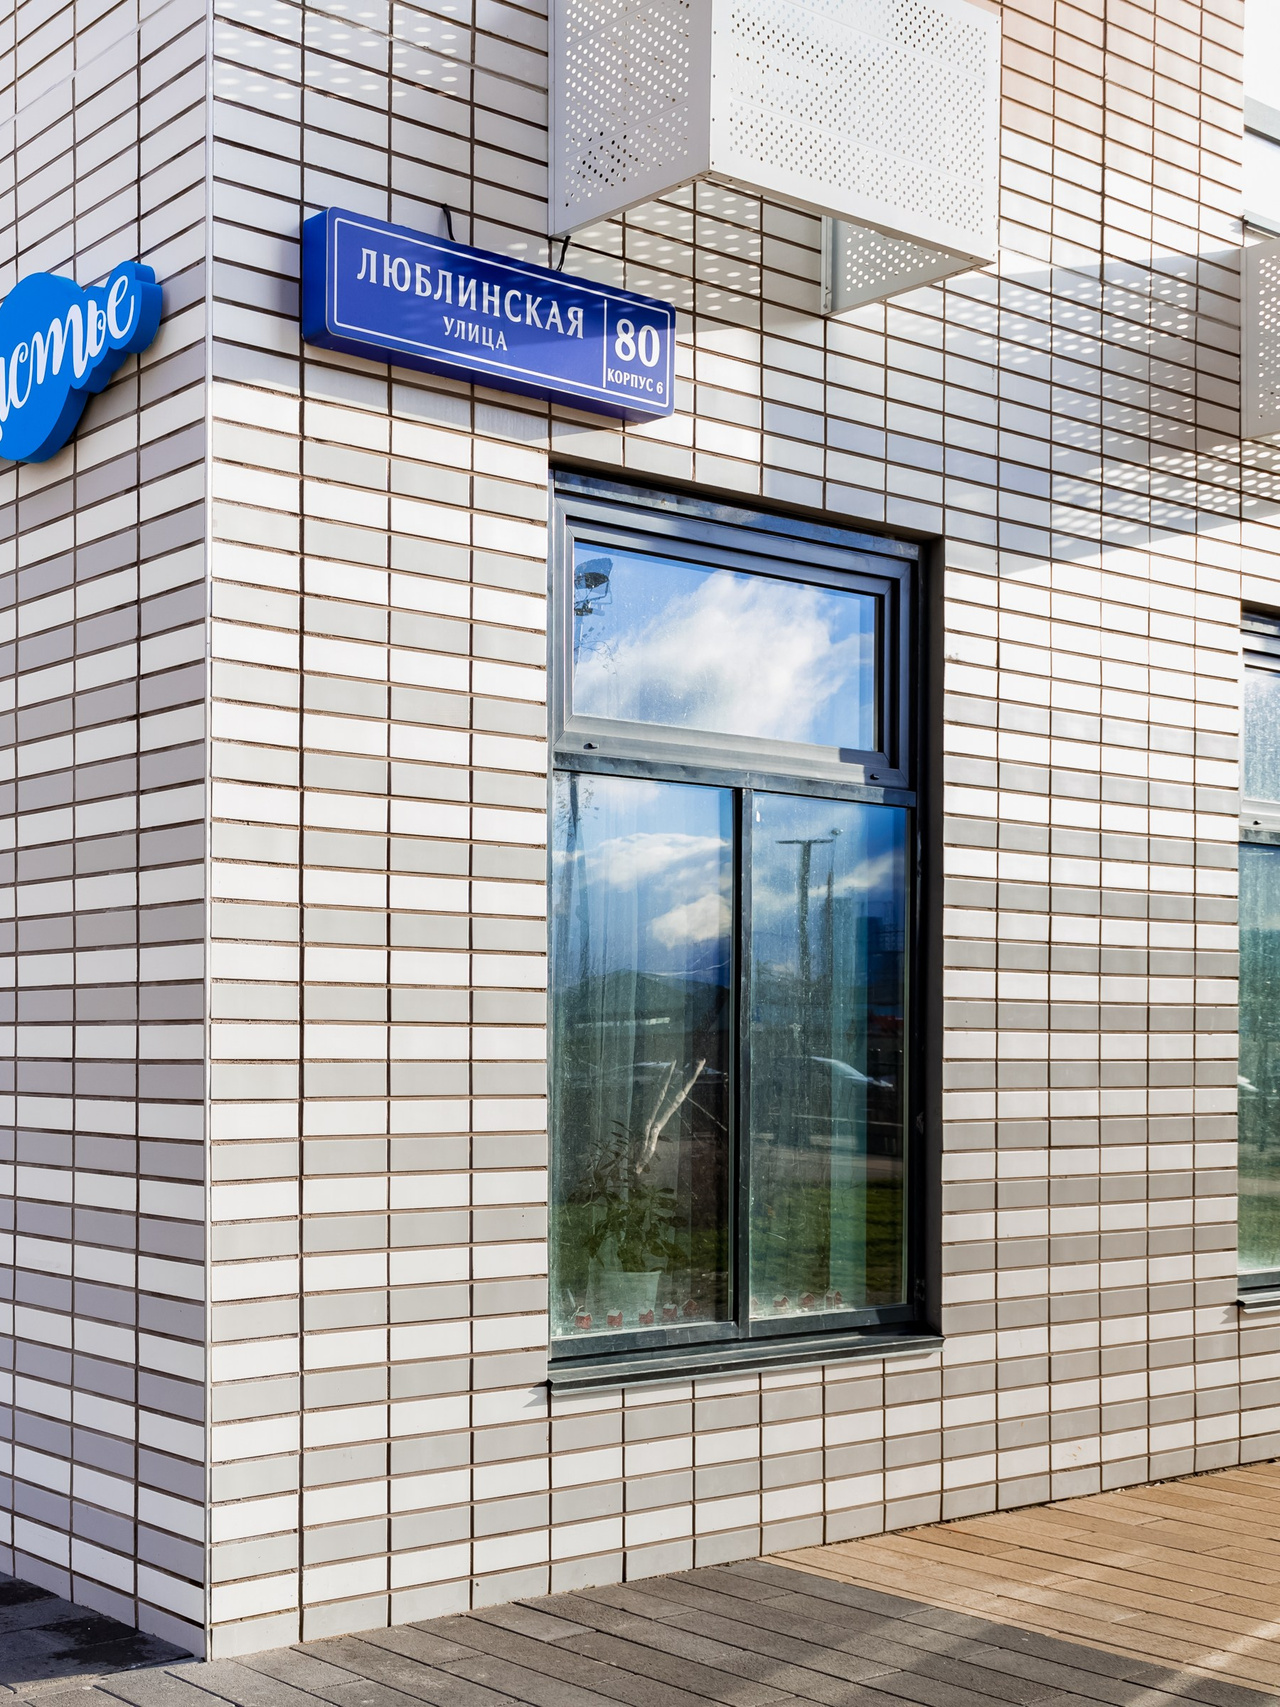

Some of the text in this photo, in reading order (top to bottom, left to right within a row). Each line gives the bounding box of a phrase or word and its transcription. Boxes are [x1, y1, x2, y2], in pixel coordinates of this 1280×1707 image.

[356, 247, 661, 368] ЛЮБЛИНСКАЯ 80
[442, 315, 508, 352] УЛИЦА
[606, 366, 664, 395] КОРПУС 6
